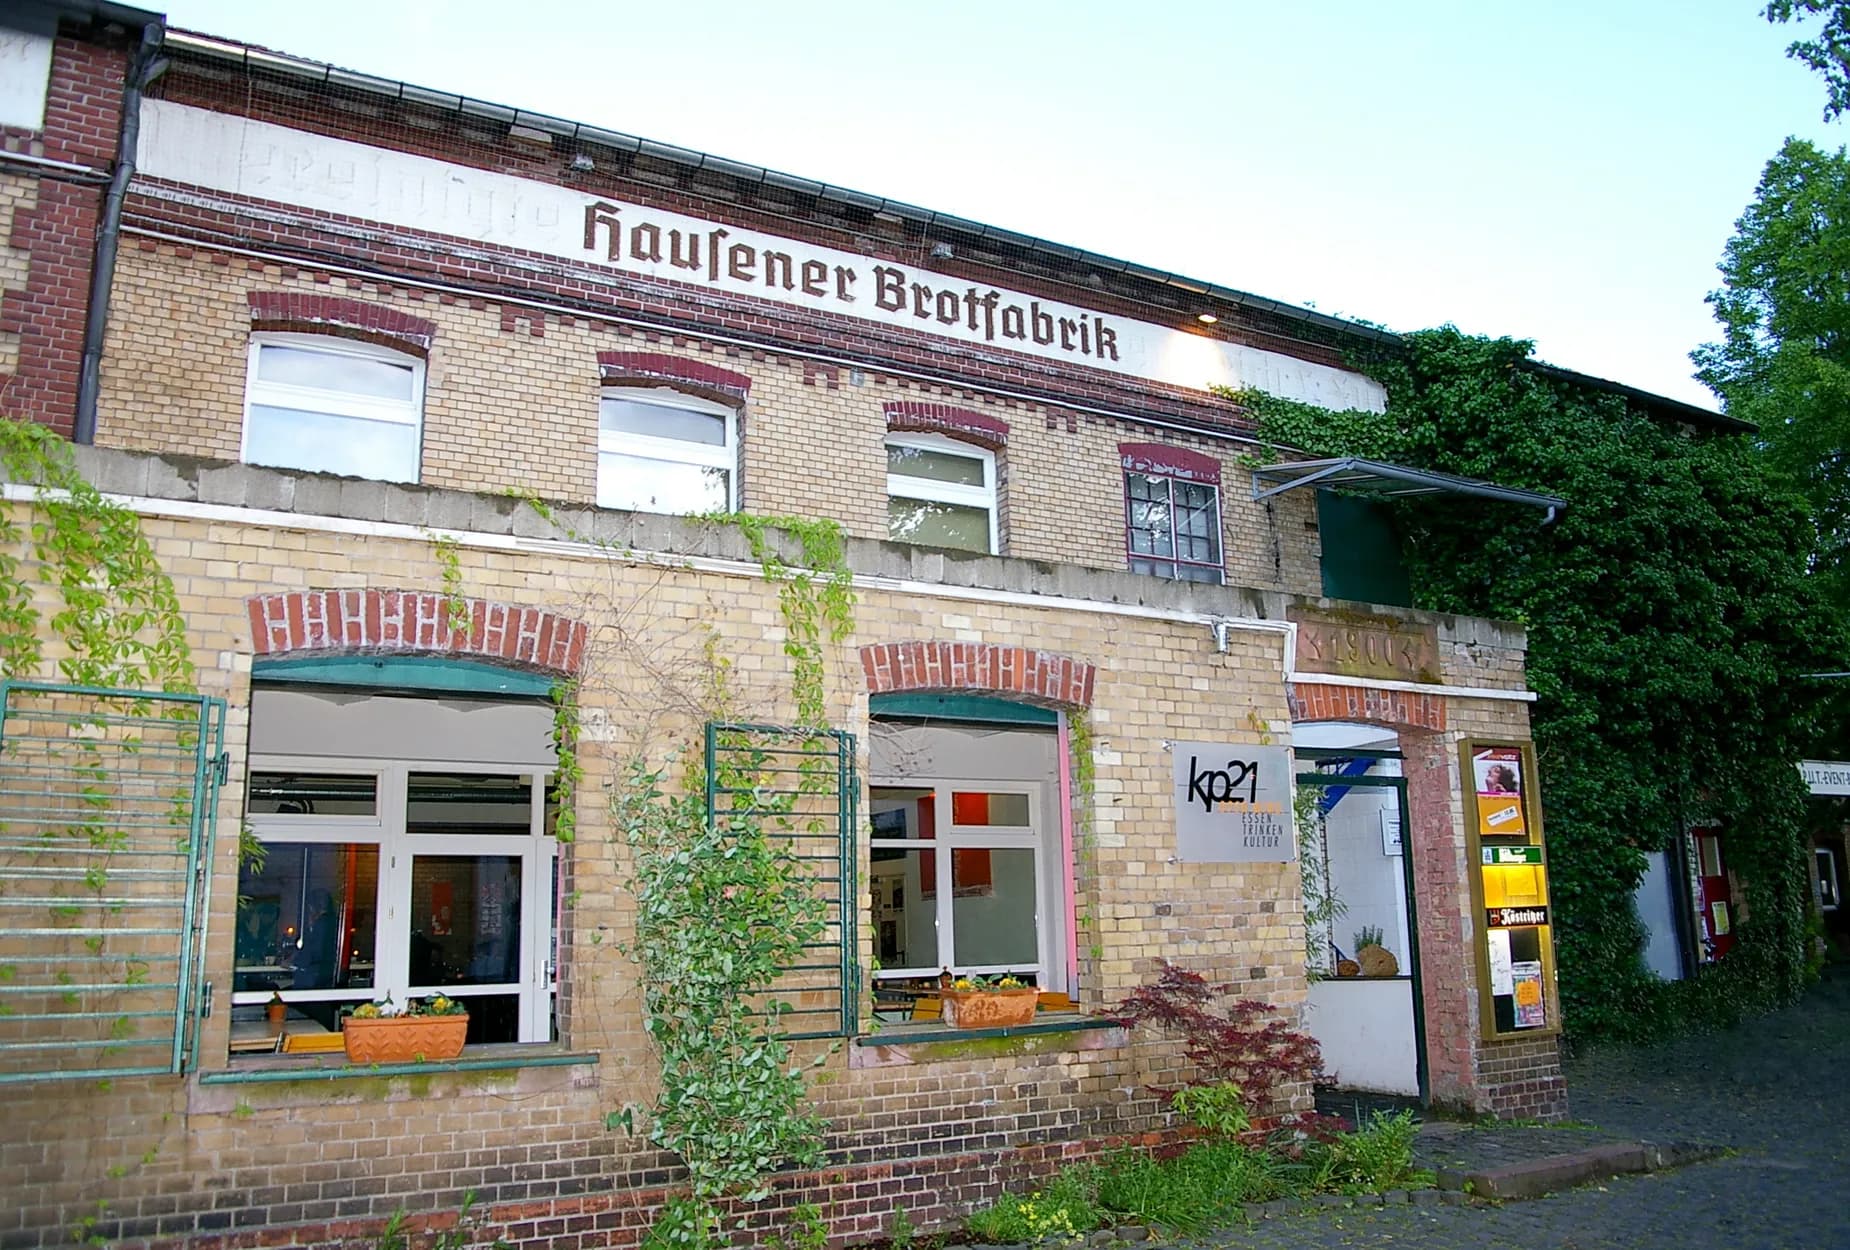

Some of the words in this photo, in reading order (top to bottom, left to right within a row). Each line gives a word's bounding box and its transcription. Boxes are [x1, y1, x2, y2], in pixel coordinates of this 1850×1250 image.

[873, 262, 1120, 361] Brotfabrik
[1188, 756, 1258, 812] kp21
[1242, 812, 1272, 824] ESSEN
[1243, 824, 1283, 836] TRINKEN
[1243, 836, 1279, 848] KULTUR
